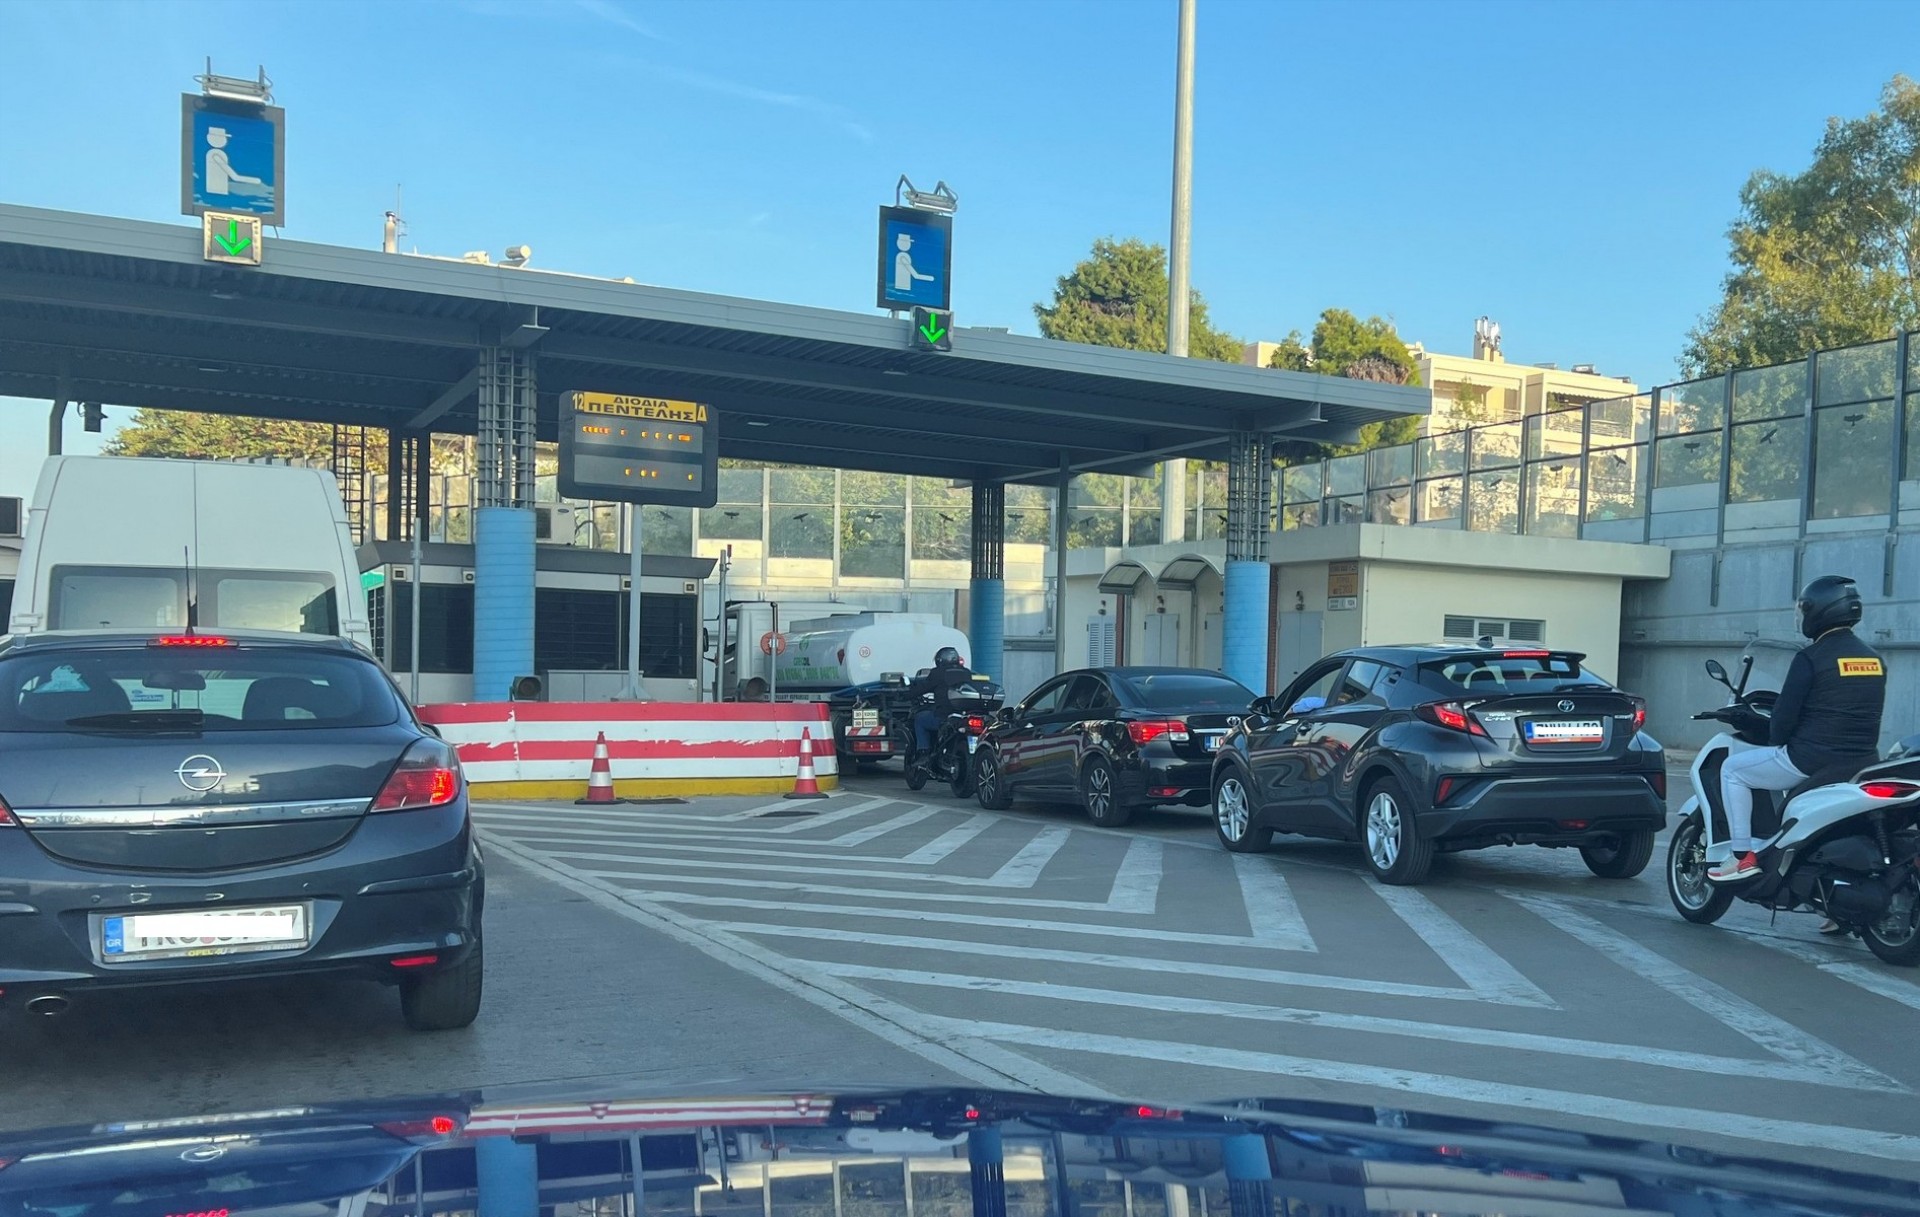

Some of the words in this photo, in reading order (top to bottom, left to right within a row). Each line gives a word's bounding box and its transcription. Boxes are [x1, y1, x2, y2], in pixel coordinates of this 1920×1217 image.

[572, 392, 584, 410] 12
[613, 396, 669, 408] ΔΙΟΔΙΑ
[588, 402, 694, 421] ΠΕΝΤΕΛΗΣ
[1843, 662, 1879, 672] PIRELLI
[106, 938, 122, 947] GR
